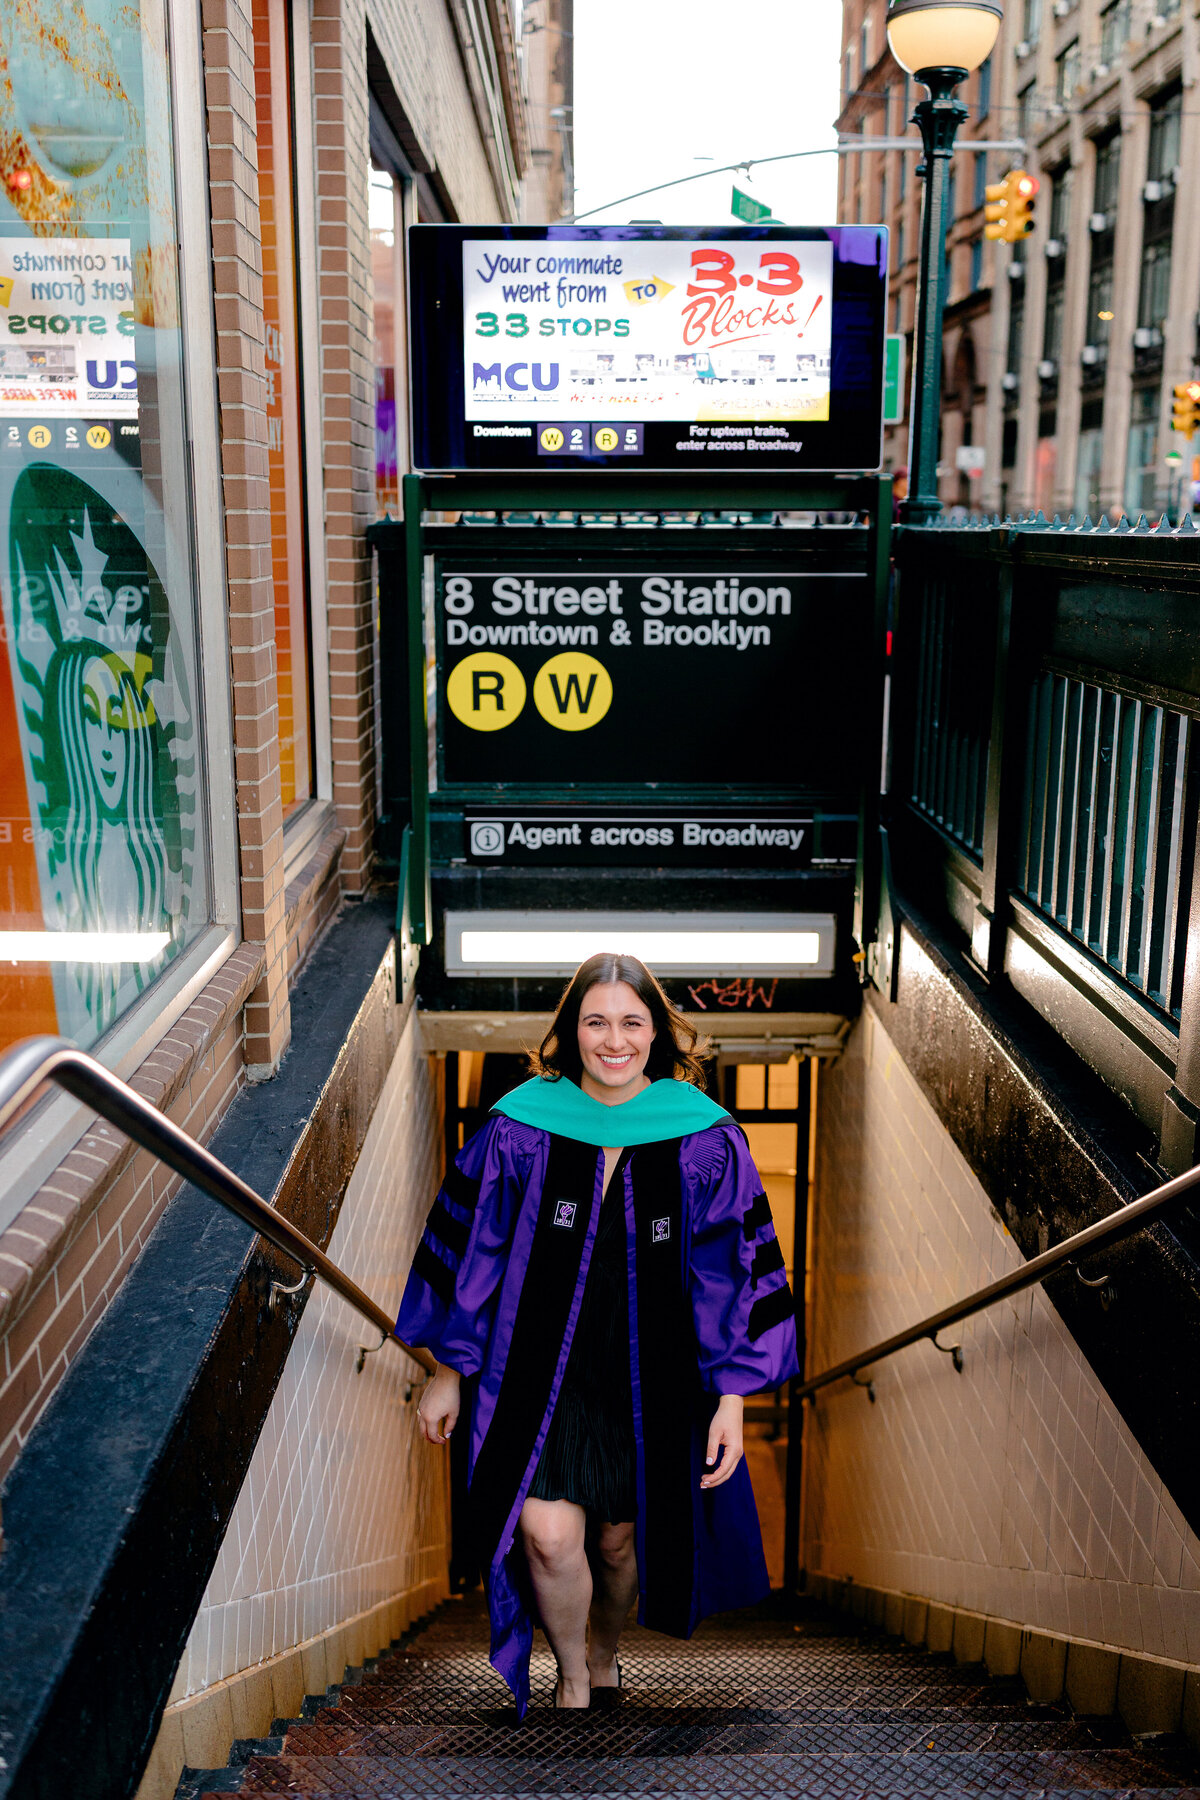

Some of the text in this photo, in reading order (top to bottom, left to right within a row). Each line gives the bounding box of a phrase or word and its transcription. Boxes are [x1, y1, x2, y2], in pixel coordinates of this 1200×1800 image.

[476, 253, 623, 283] Your commute
[502, 276, 607, 308] went from
[632, 283, 657, 300] TO
[475, 312, 630, 338] 33 STOPS
[681, 294, 823, 346] Blocks!
[472, 362, 560, 392] MCU
[473, 425, 532, 437] Downtown
[545, 428, 583, 446] W 2
[602, 428, 638, 446] R 5
[689, 425, 790, 438] For uptown trains,
[676, 439, 803, 453] enter across Broadway
[444, 577, 792, 616] 8 Street Station
[446, 619, 771, 651] Downtown & Brooklyn
[472, 671, 599, 714] R W
[507, 822, 582, 850] Agent
[590, 827, 674, 846] across
[683, 823, 804, 851] Broadway
